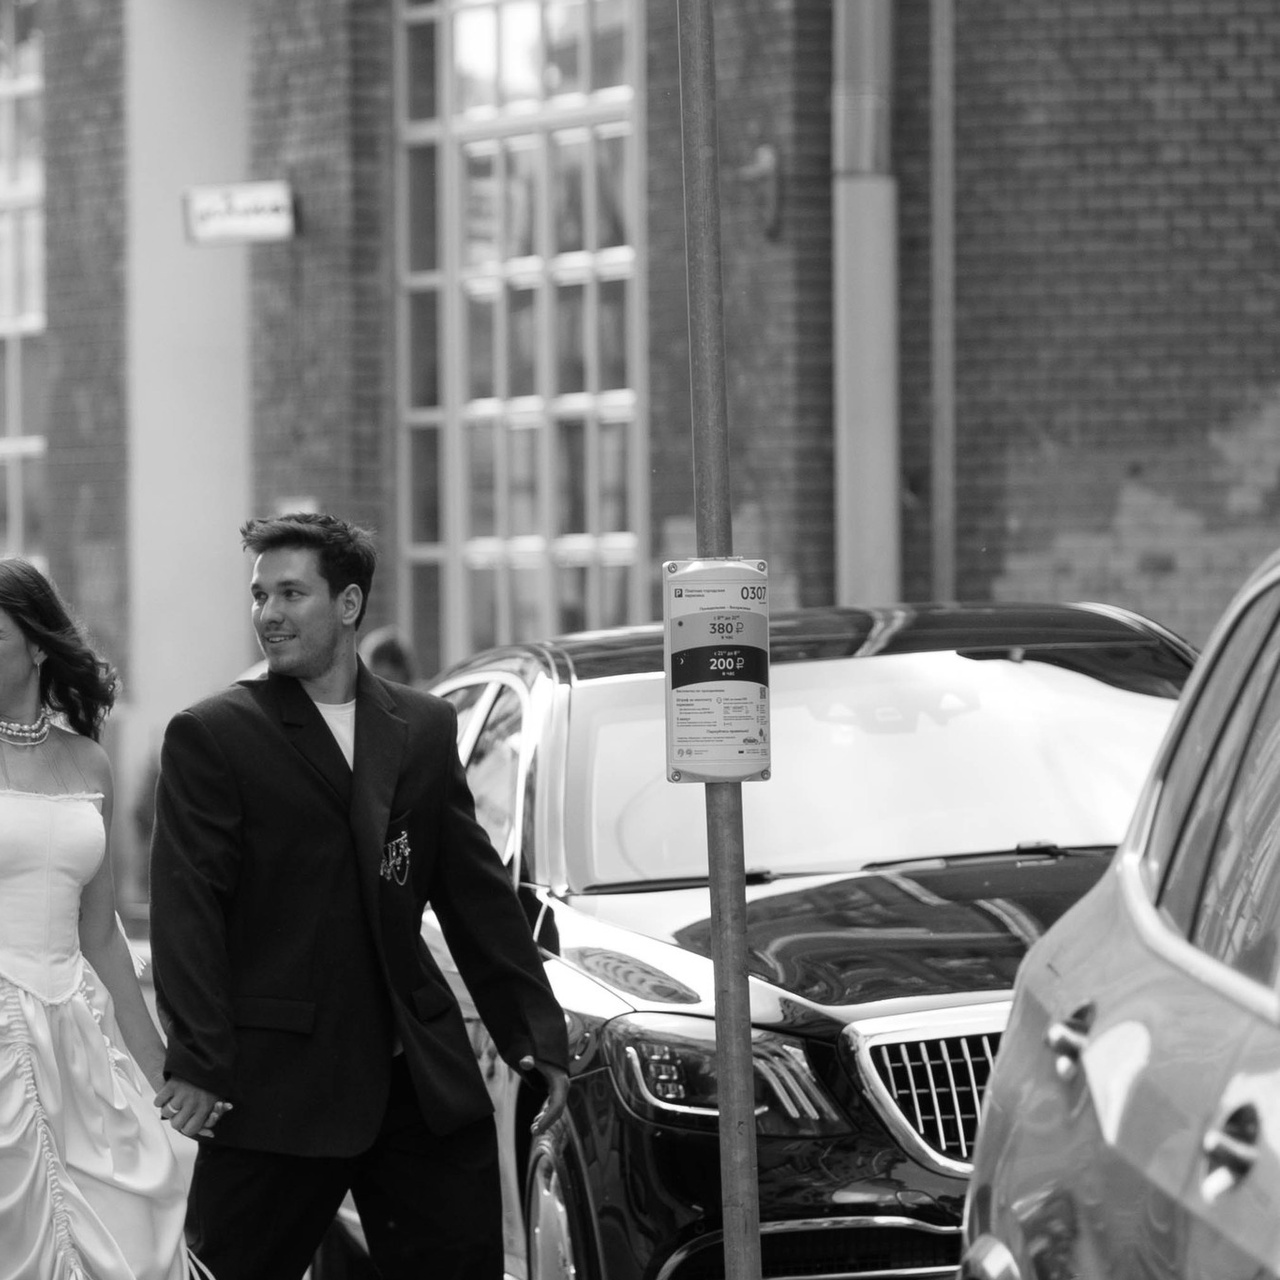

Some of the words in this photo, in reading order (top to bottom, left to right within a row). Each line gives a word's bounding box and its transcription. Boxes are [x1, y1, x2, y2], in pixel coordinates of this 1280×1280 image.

[740, 586, 766, 600] 0307
[709, 623, 733, 634] 380
[709, 658, 734, 670] 200
